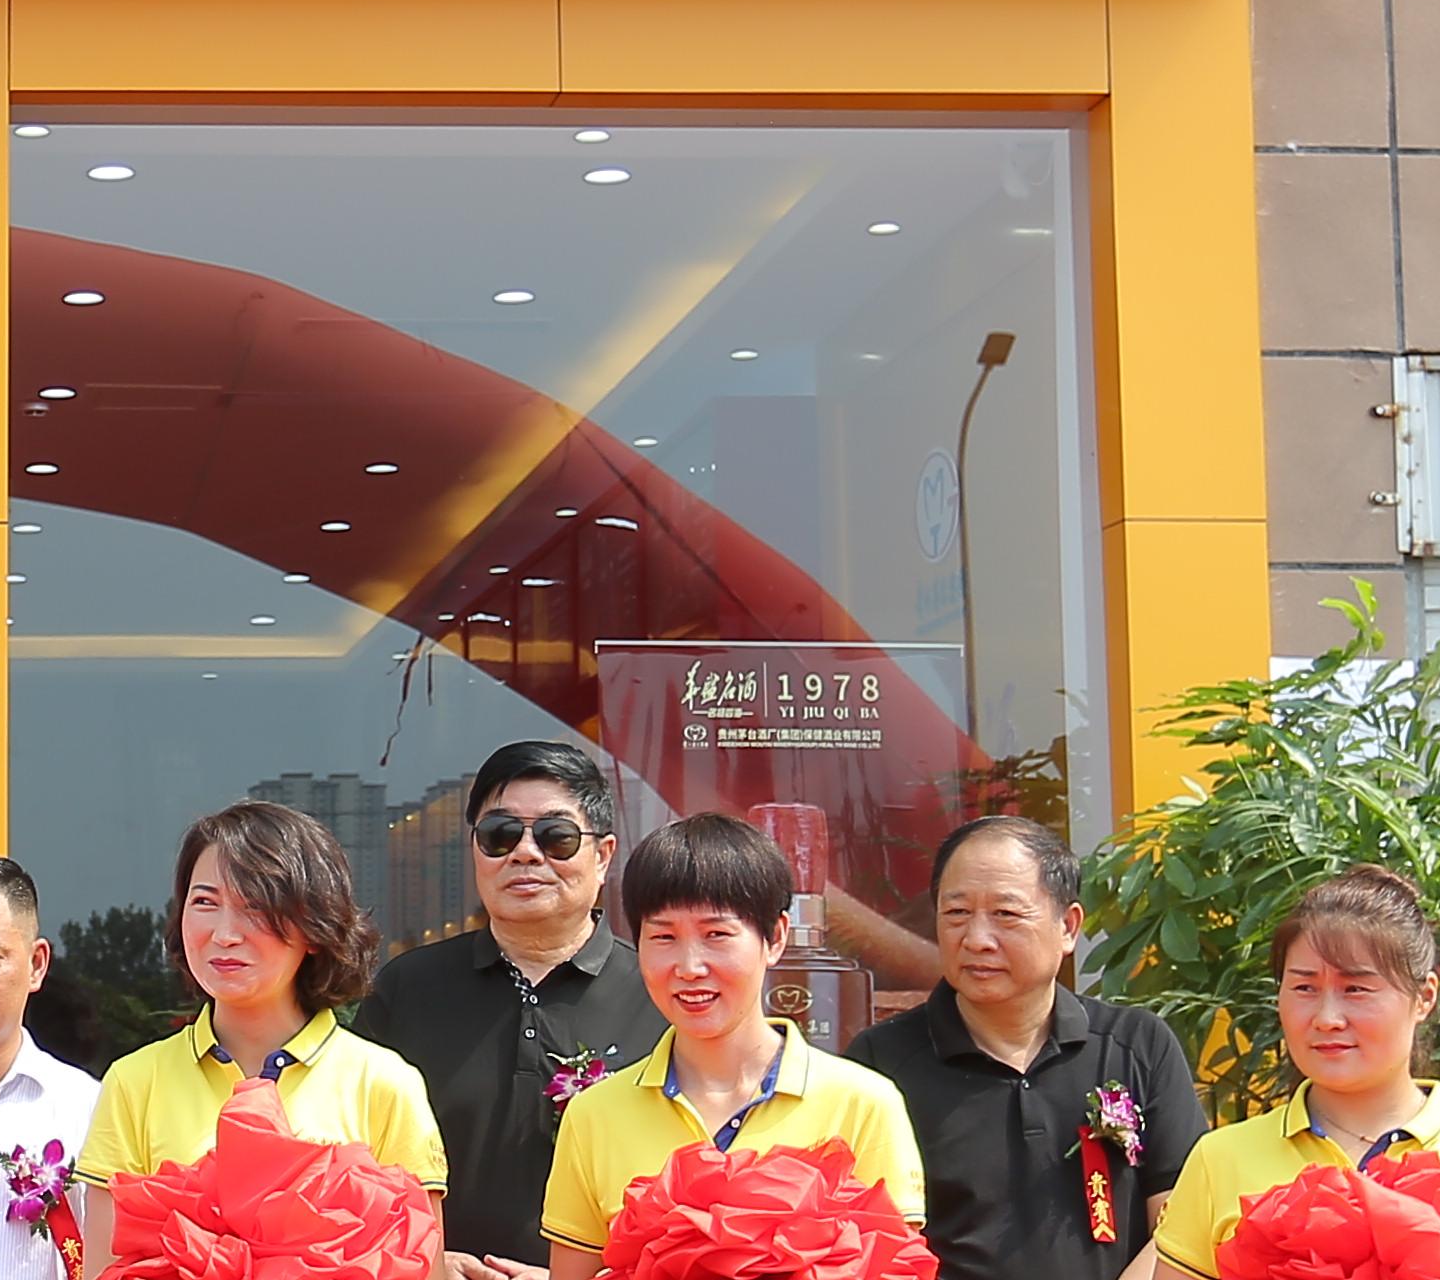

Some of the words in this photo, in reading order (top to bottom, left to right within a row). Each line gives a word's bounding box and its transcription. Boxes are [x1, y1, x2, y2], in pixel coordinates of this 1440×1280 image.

[779, 706, 795, 718] YI
[803, 706, 825, 719] JIU
[833, 706, 849, 719] QI
[861, 706, 880, 718] BA
